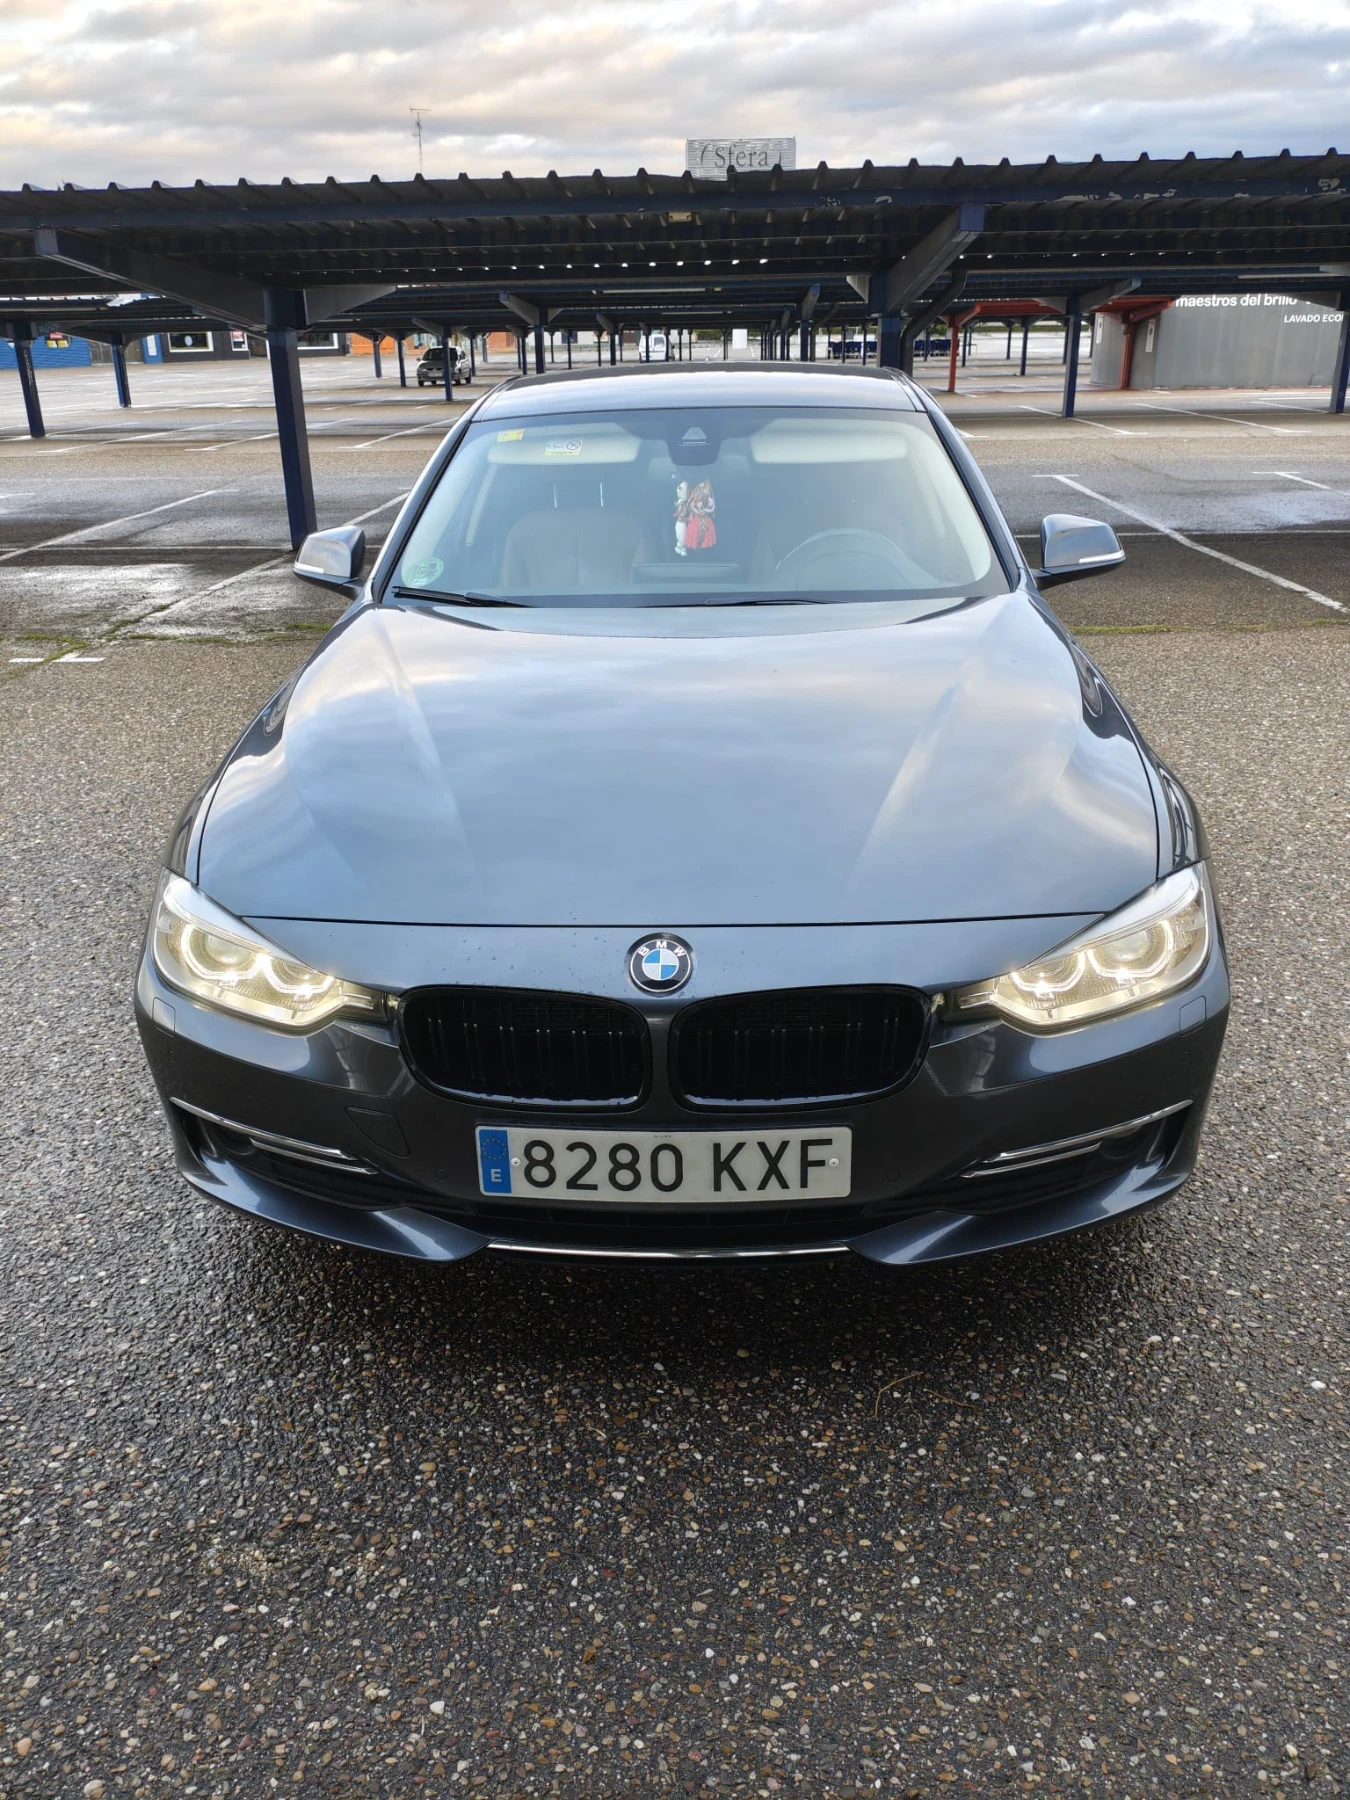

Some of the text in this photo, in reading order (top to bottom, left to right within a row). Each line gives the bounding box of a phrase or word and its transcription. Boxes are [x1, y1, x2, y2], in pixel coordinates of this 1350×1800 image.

[1175, 294, 1237, 307] maestros
[1240, 293, 1261, 306] del
[1284, 313, 1344, 323] LAVADO ECO
[637, 940, 686, 957] BMW
[523, 1138, 833, 1192] 8280 KXF
[490, 1168, 503, 1183] E
